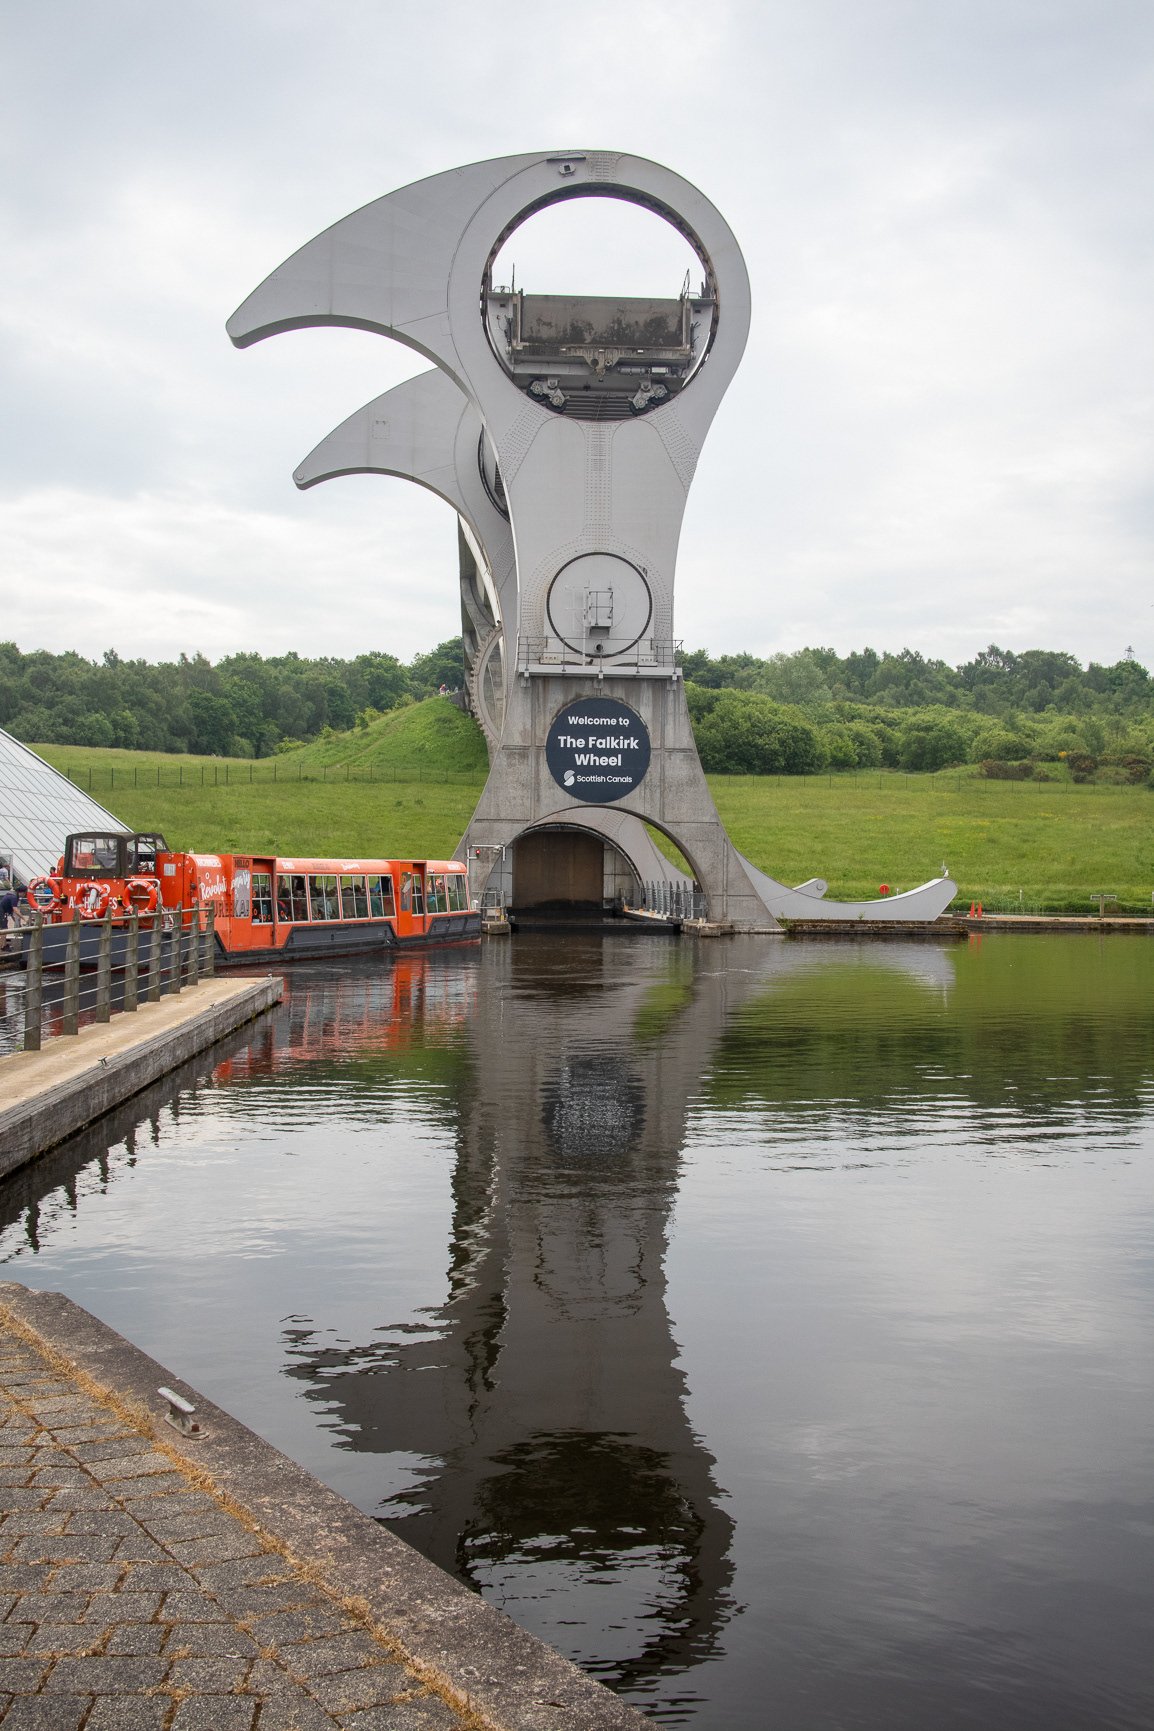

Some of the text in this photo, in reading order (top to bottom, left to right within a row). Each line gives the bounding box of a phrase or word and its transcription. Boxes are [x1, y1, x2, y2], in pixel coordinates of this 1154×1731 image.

[567, 715, 630, 726] Welcome to
[557, 735, 640, 750] The Falkirk
[574, 753, 622, 767] Wheel
[576, 775, 633, 784] Scottish Canals
[234, 859, 250, 869] HELLO
